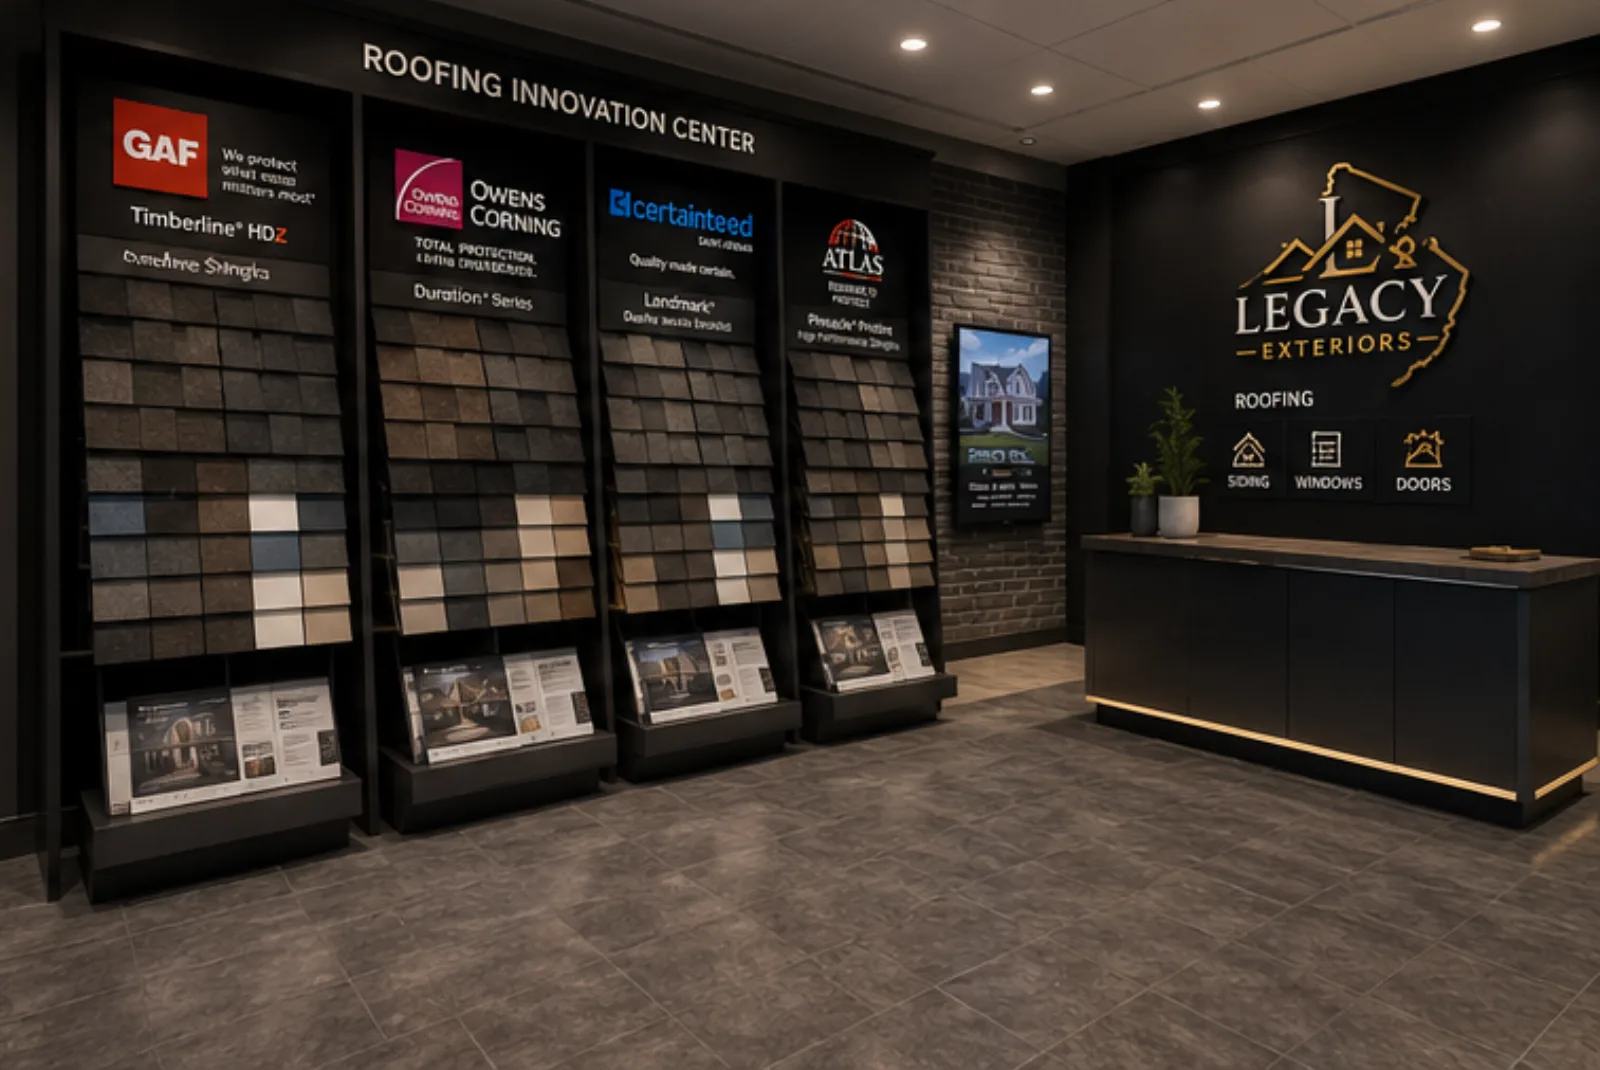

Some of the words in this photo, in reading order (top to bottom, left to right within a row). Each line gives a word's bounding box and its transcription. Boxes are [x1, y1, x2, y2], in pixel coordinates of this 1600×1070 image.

[362, 42, 502, 98] ROOFING
[512, 77, 666, 136] INNOVATION
[672, 116, 755, 155] CENTER
[123, 129, 199, 166] GAF
[470, 179, 546, 212] OWENS
[470, 204, 562, 237] CORNING
[632, 200, 753, 237] certainteed
[248, 223, 288, 244] HDZ
[822, 248, 884, 275] ATLAS
[491, 292, 533, 311] Series
[1235, 274, 1449, 335] LEGACY
[1261, 332, 1412, 360] EXTERIORS
[1234, 390, 1314, 410] ROOFING
[1295, 475, 1363, 490] WINDOWS
[1396, 476, 1452, 492] DOORS
